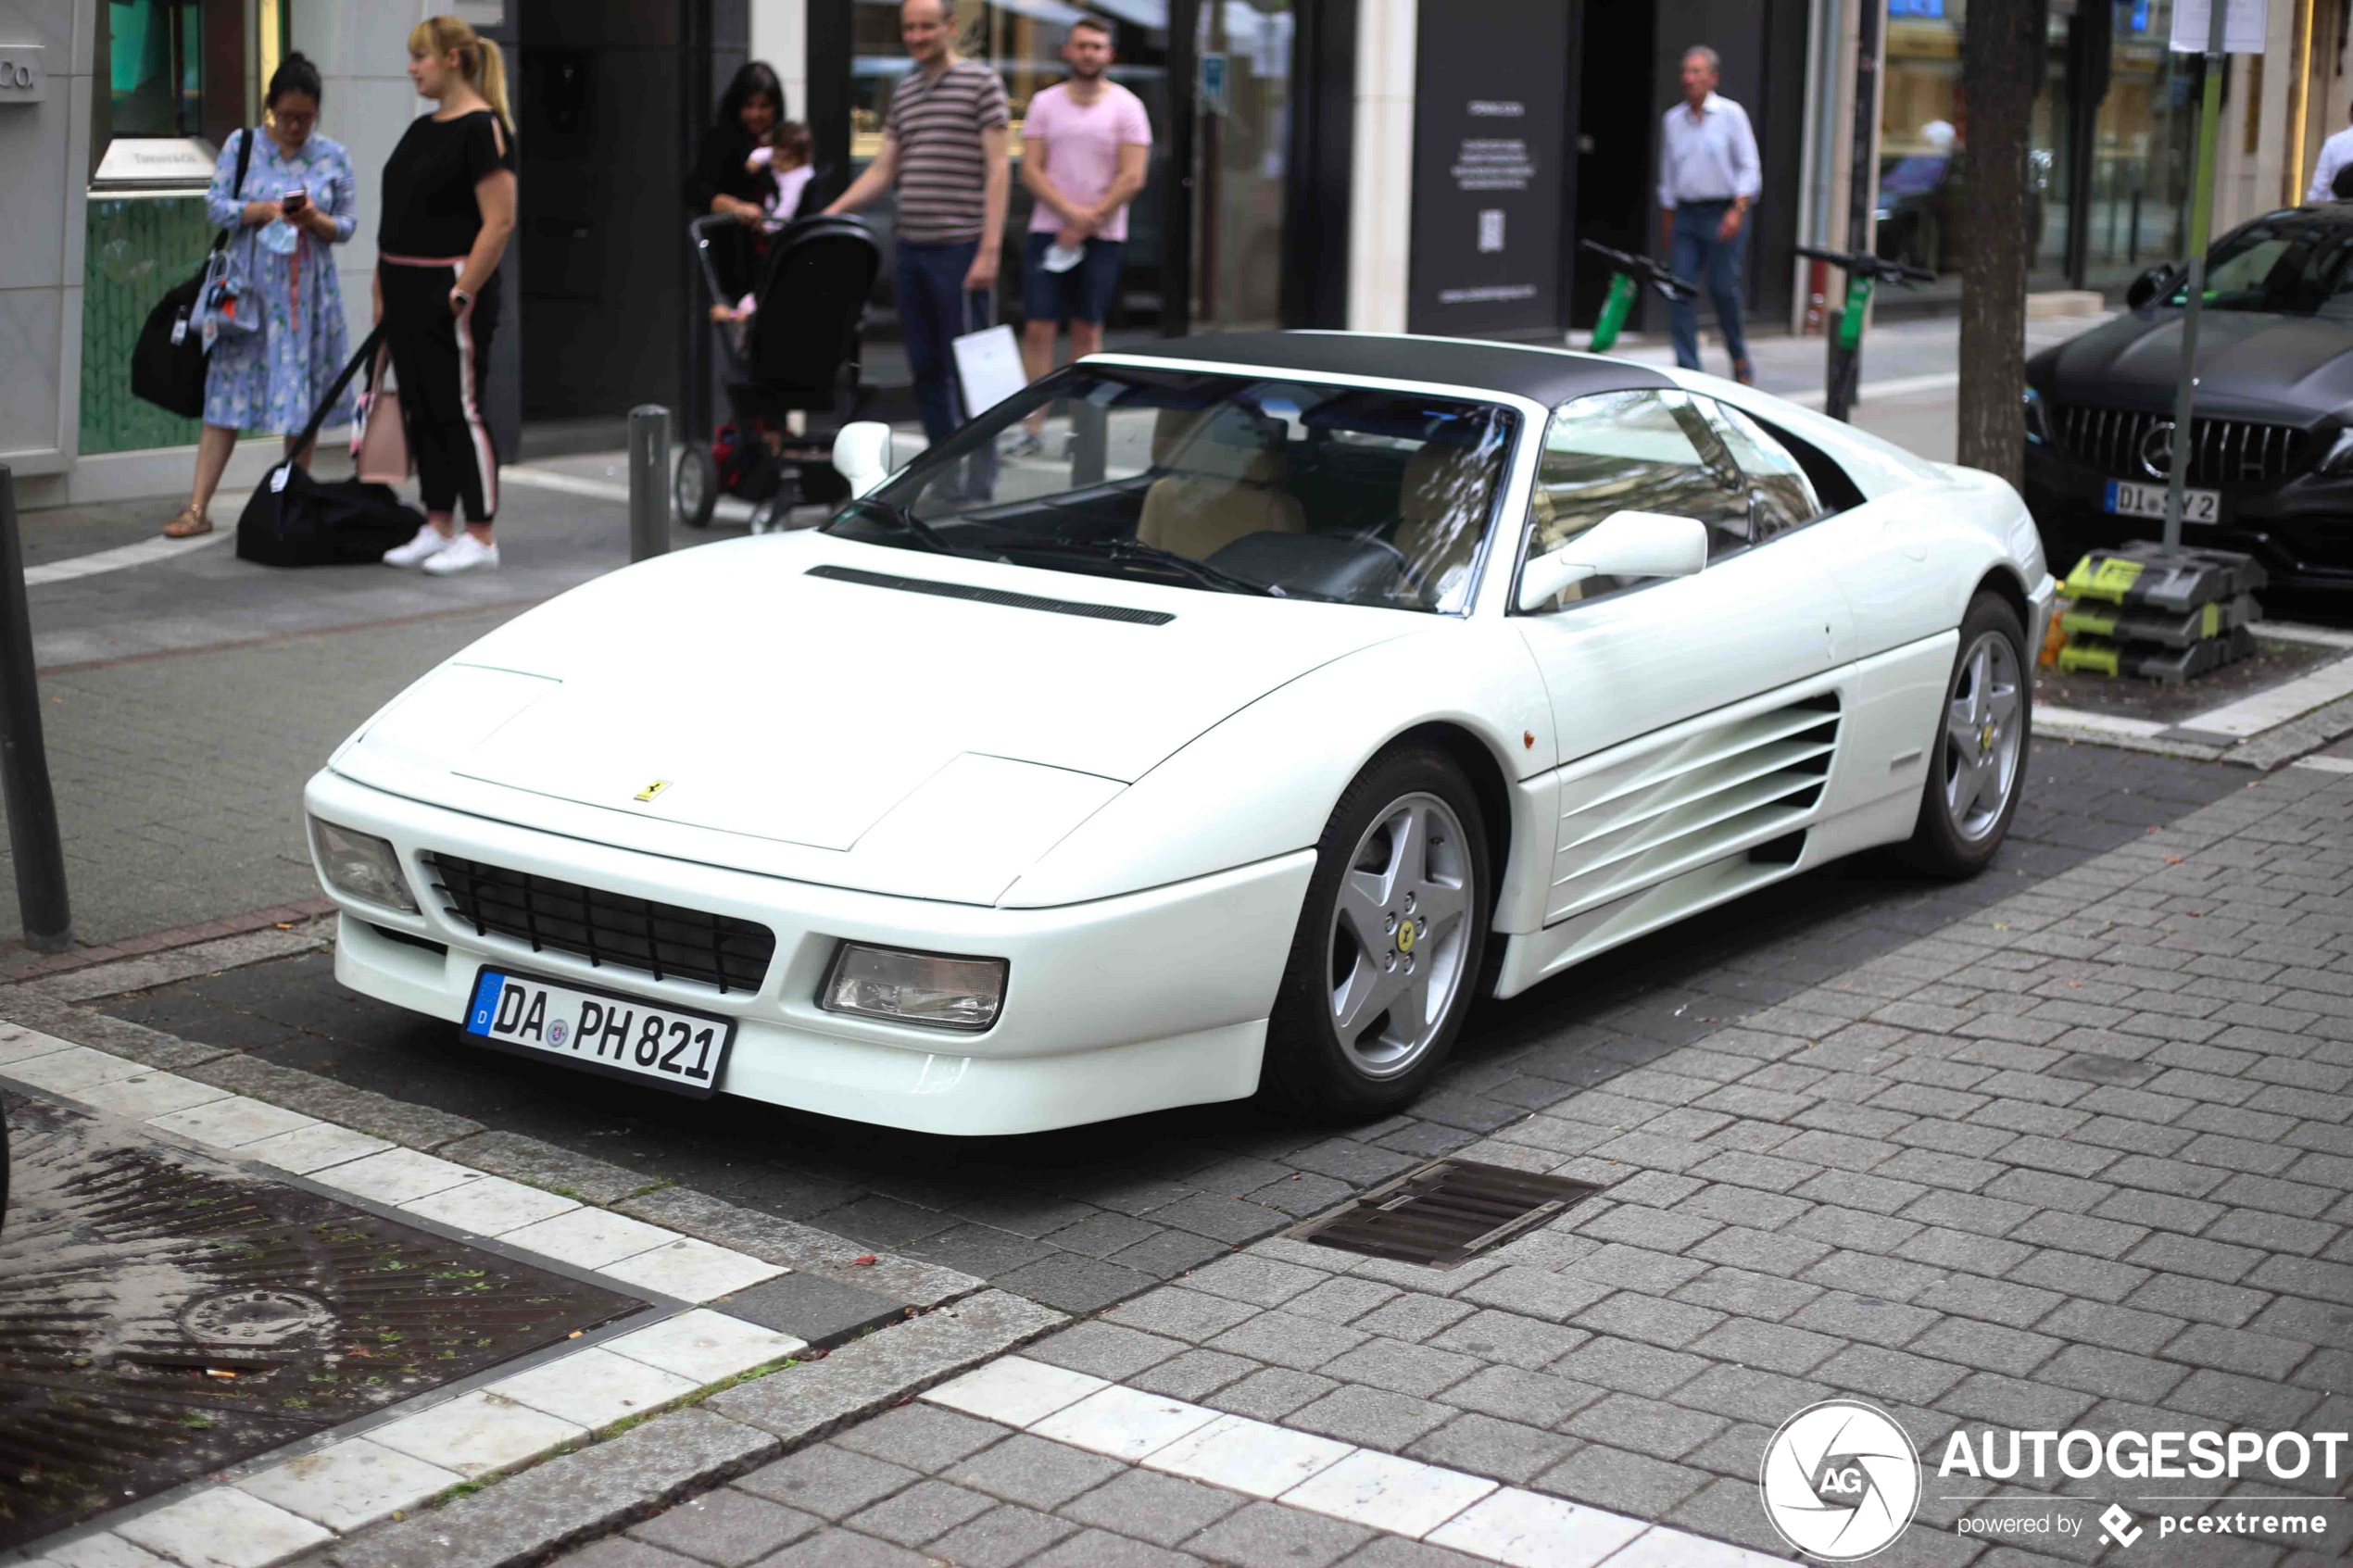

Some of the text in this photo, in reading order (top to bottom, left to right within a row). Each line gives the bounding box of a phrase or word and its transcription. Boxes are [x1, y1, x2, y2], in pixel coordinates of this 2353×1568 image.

[477, 1010, 487, 1024] D
[494, 983, 715, 1081] DA PH 821
